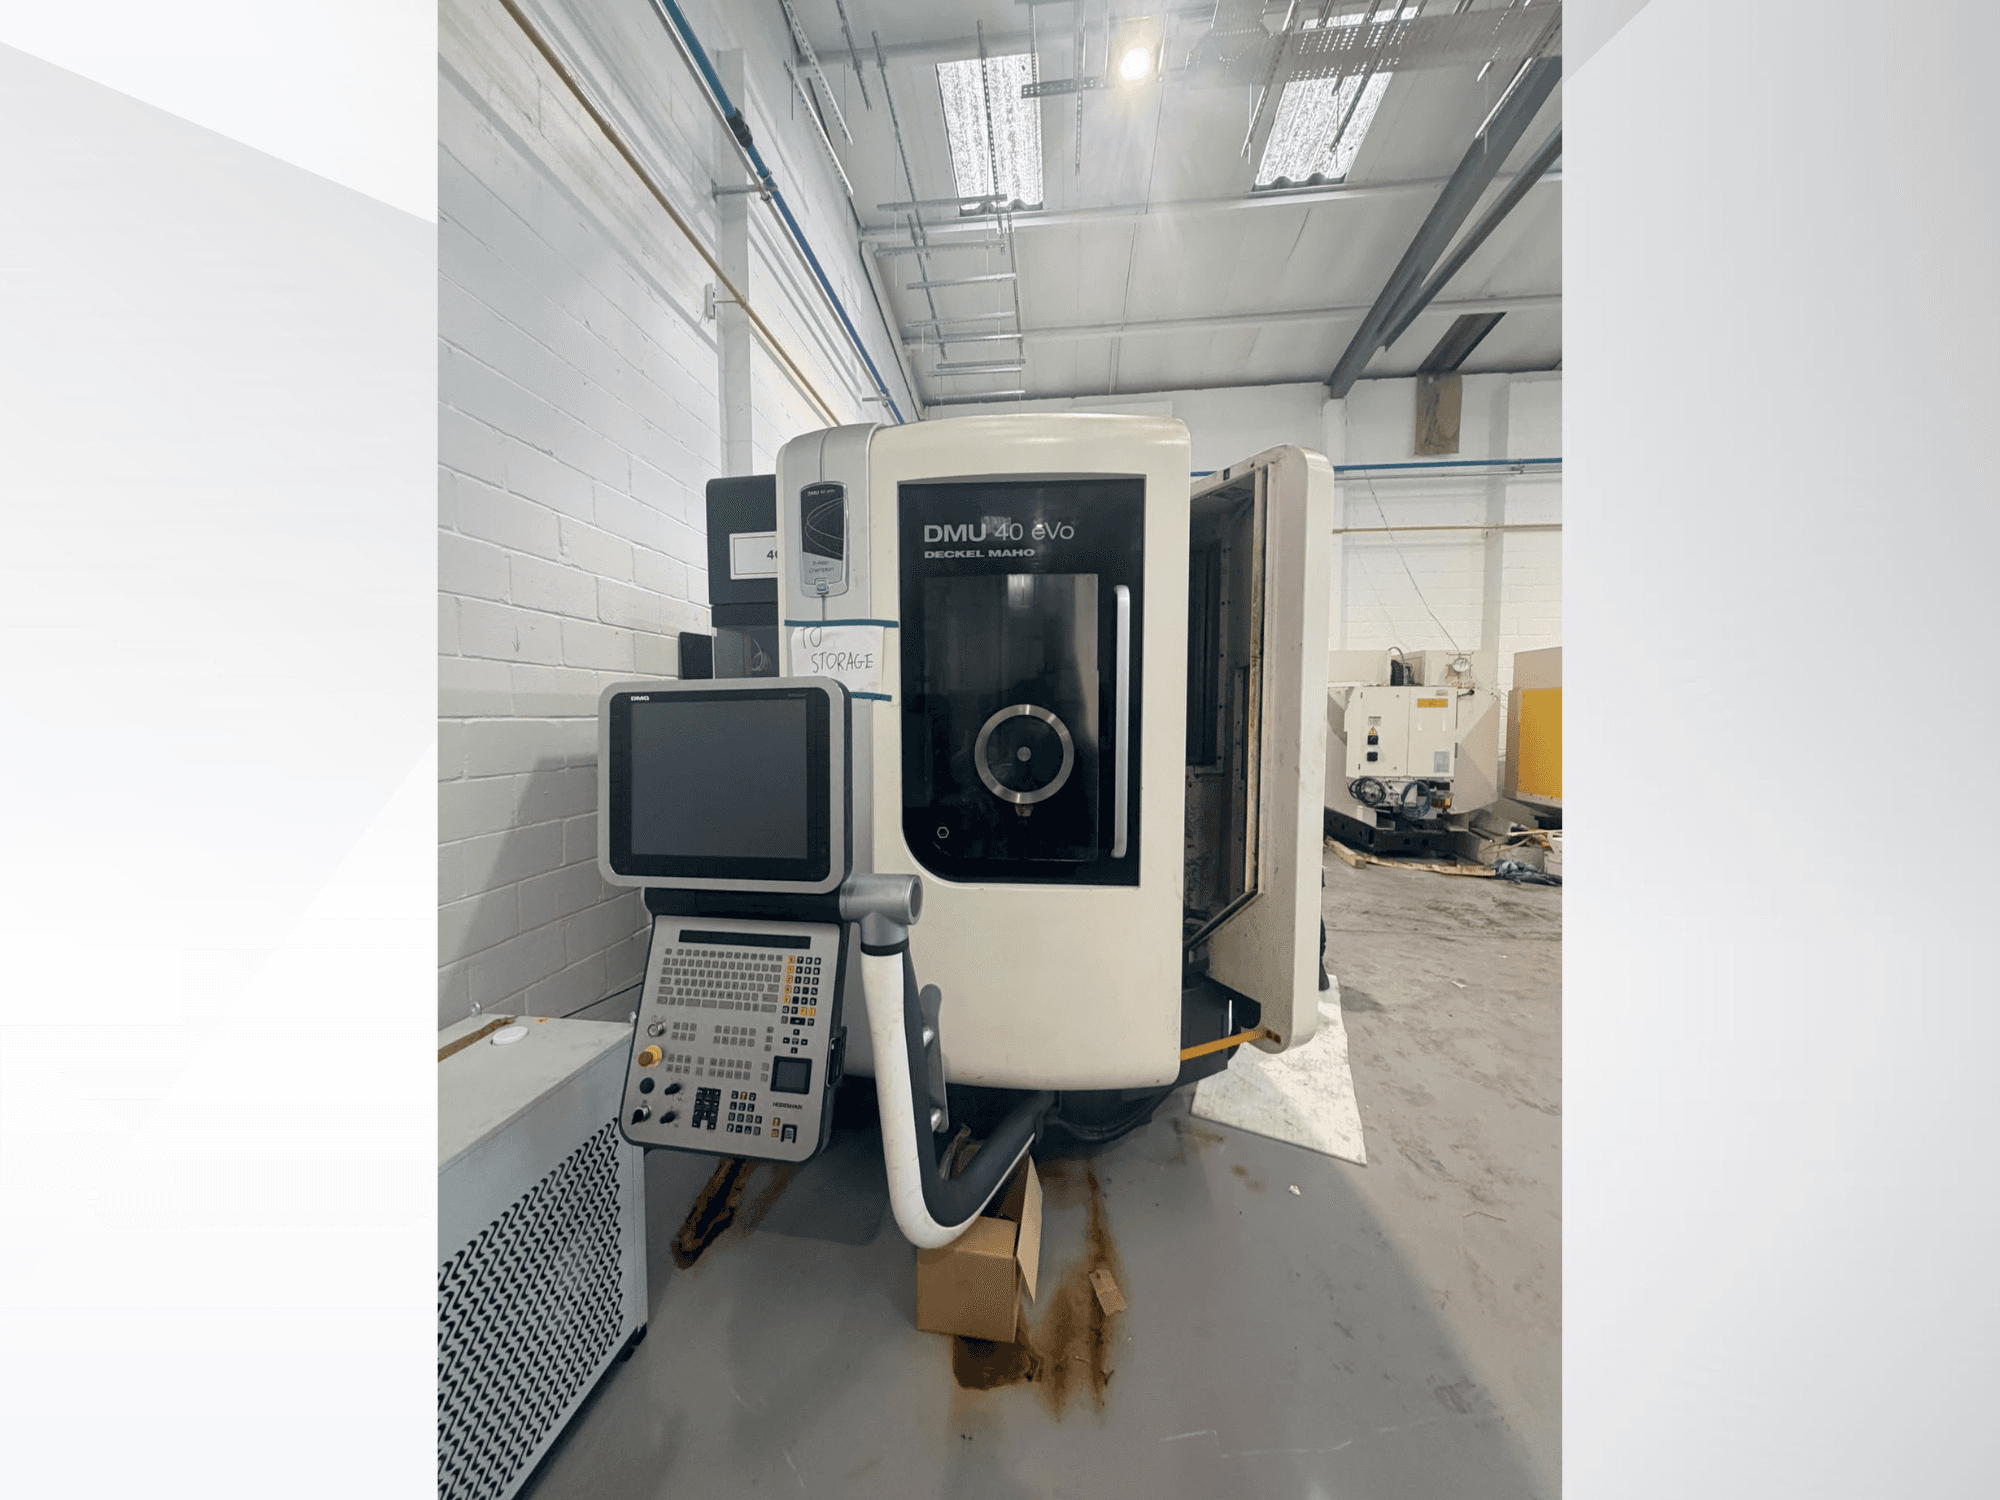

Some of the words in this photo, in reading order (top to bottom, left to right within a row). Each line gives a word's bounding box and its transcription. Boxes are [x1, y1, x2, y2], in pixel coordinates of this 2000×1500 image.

[924, 523, 987, 543] DMU
[994, 522, 1024, 541] 40
[1031, 521, 1075, 541] eVo
[924, 549, 985, 559] DECKEL
[988, 548, 1036, 558] MAHO
[800, 626, 823, 649] TO
[811, 651, 875, 674] STORAGE
